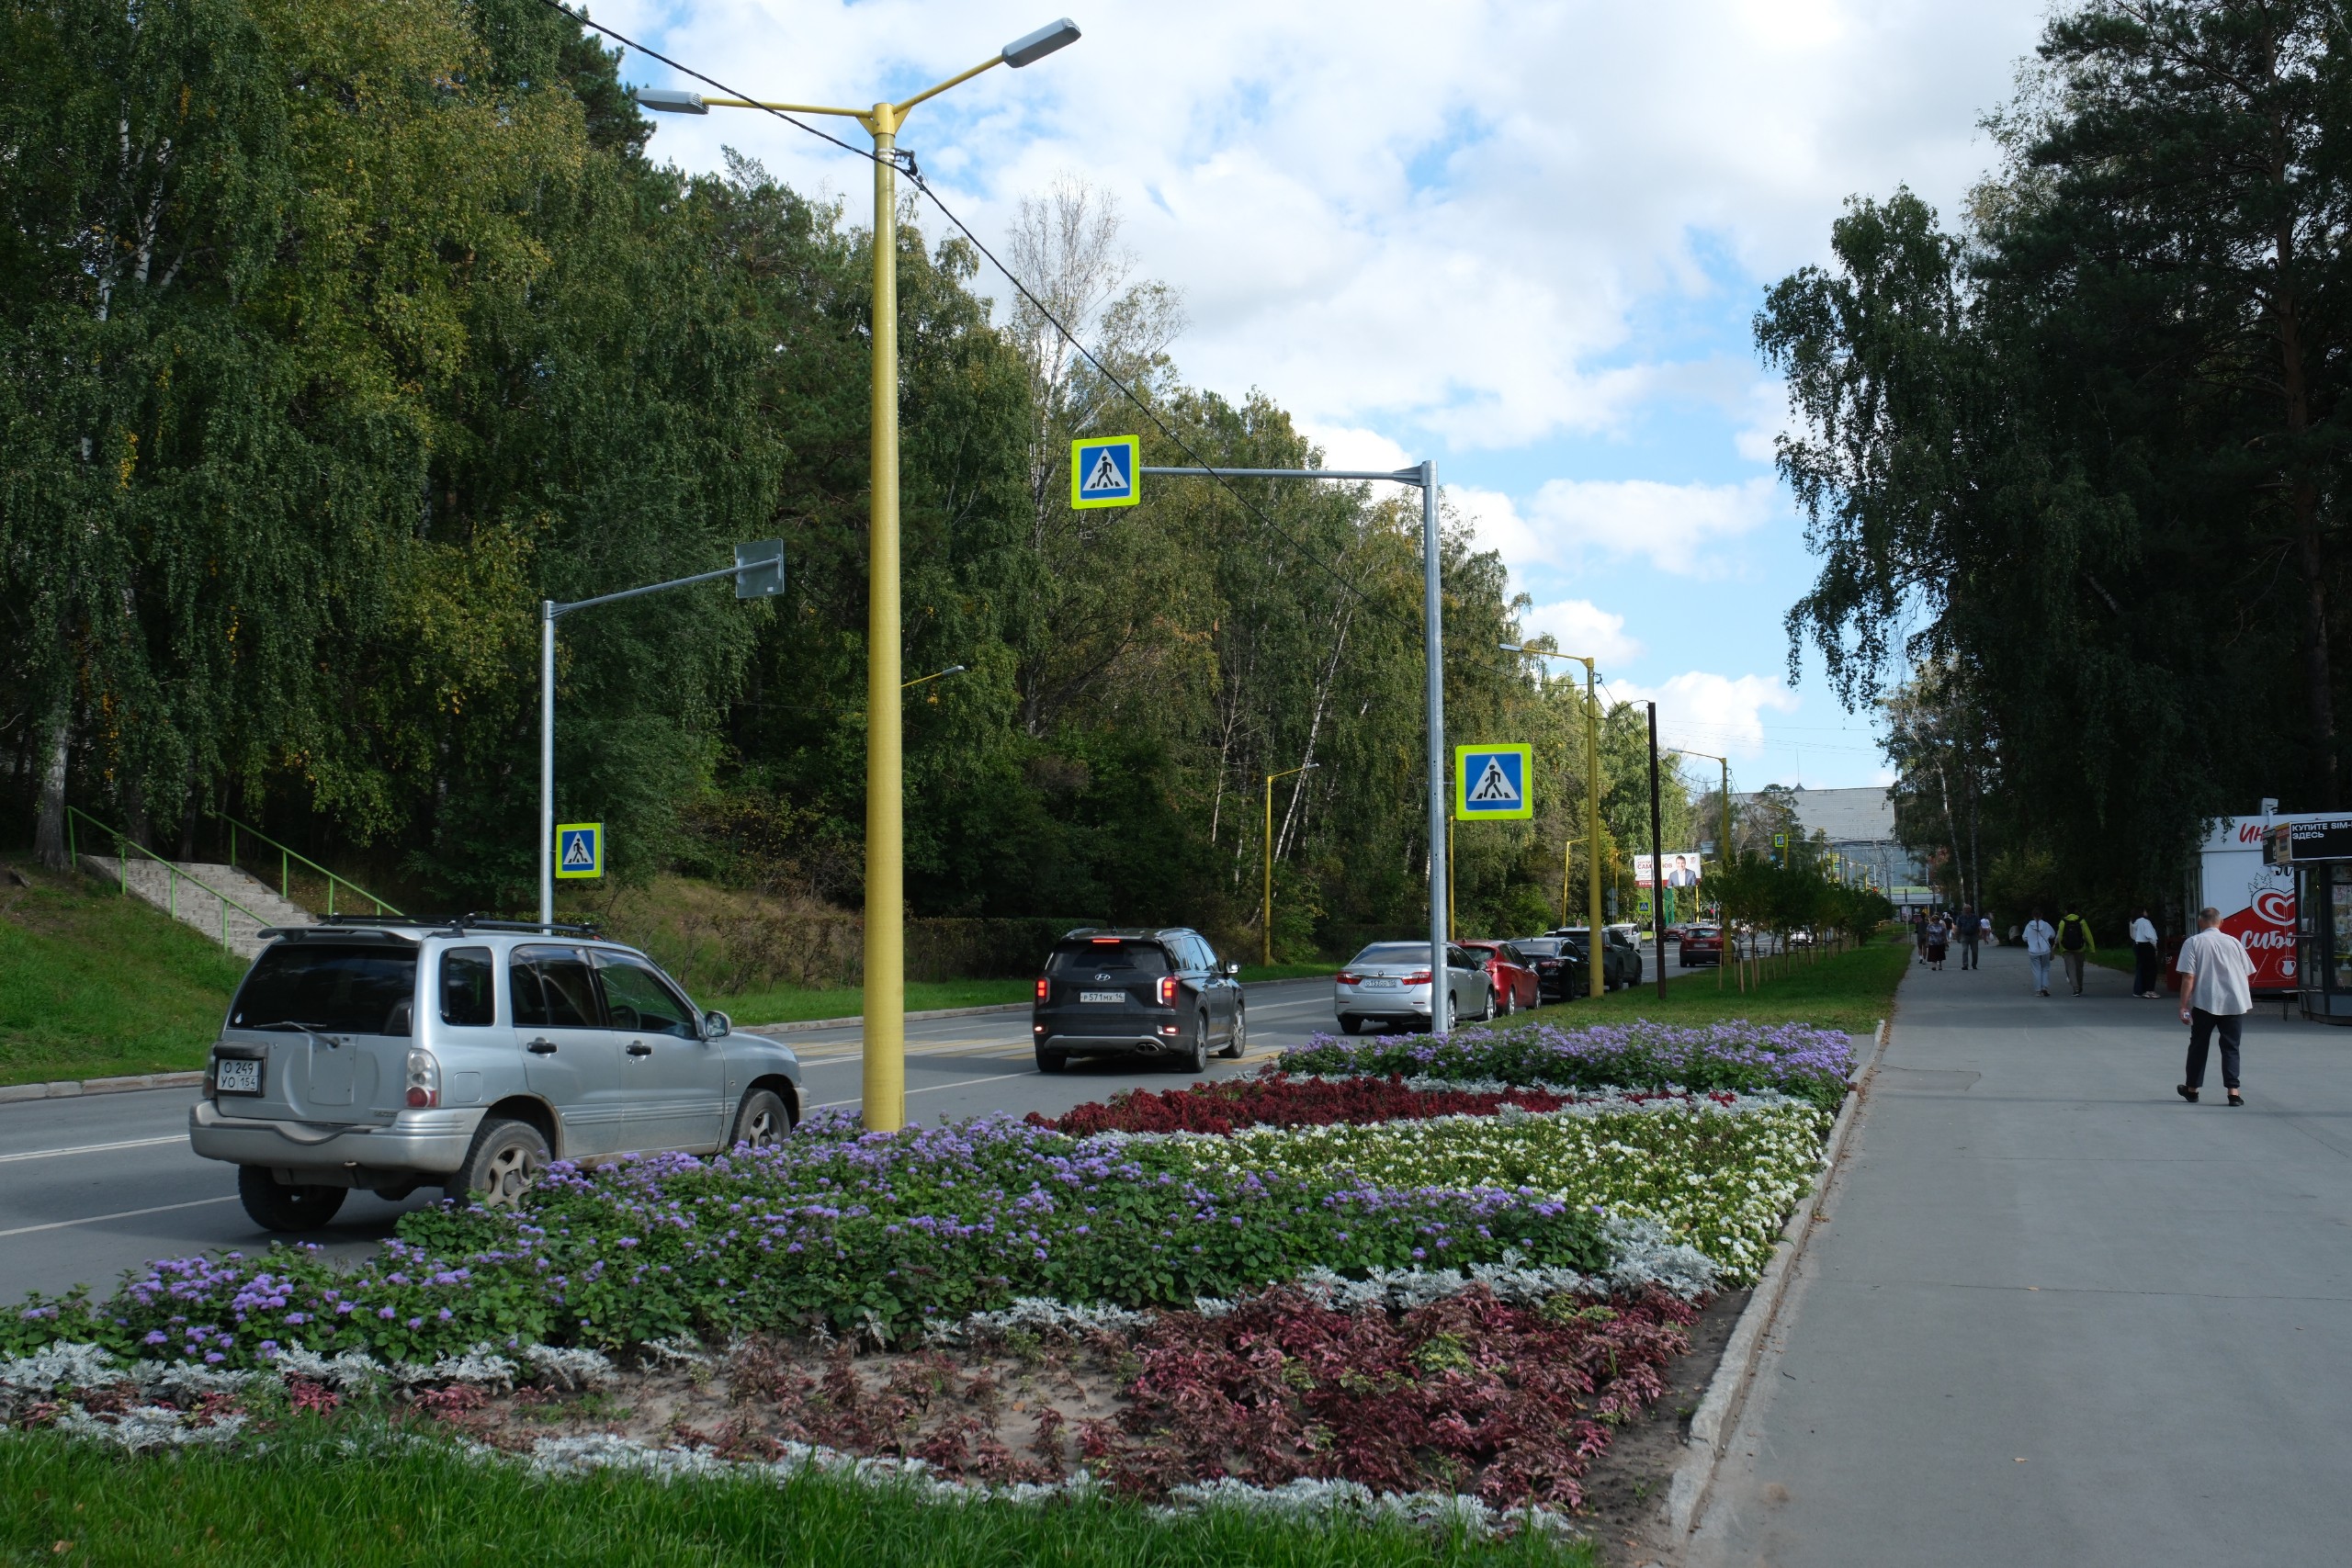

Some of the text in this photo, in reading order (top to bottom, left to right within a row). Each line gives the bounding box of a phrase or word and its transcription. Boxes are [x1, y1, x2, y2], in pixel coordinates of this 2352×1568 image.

[2291, 823, 2328, 832] КУПИТЕ
[2330, 821, 2352, 829] SIM-
[2291, 831, 2324, 840] ЗДЕСЬ
